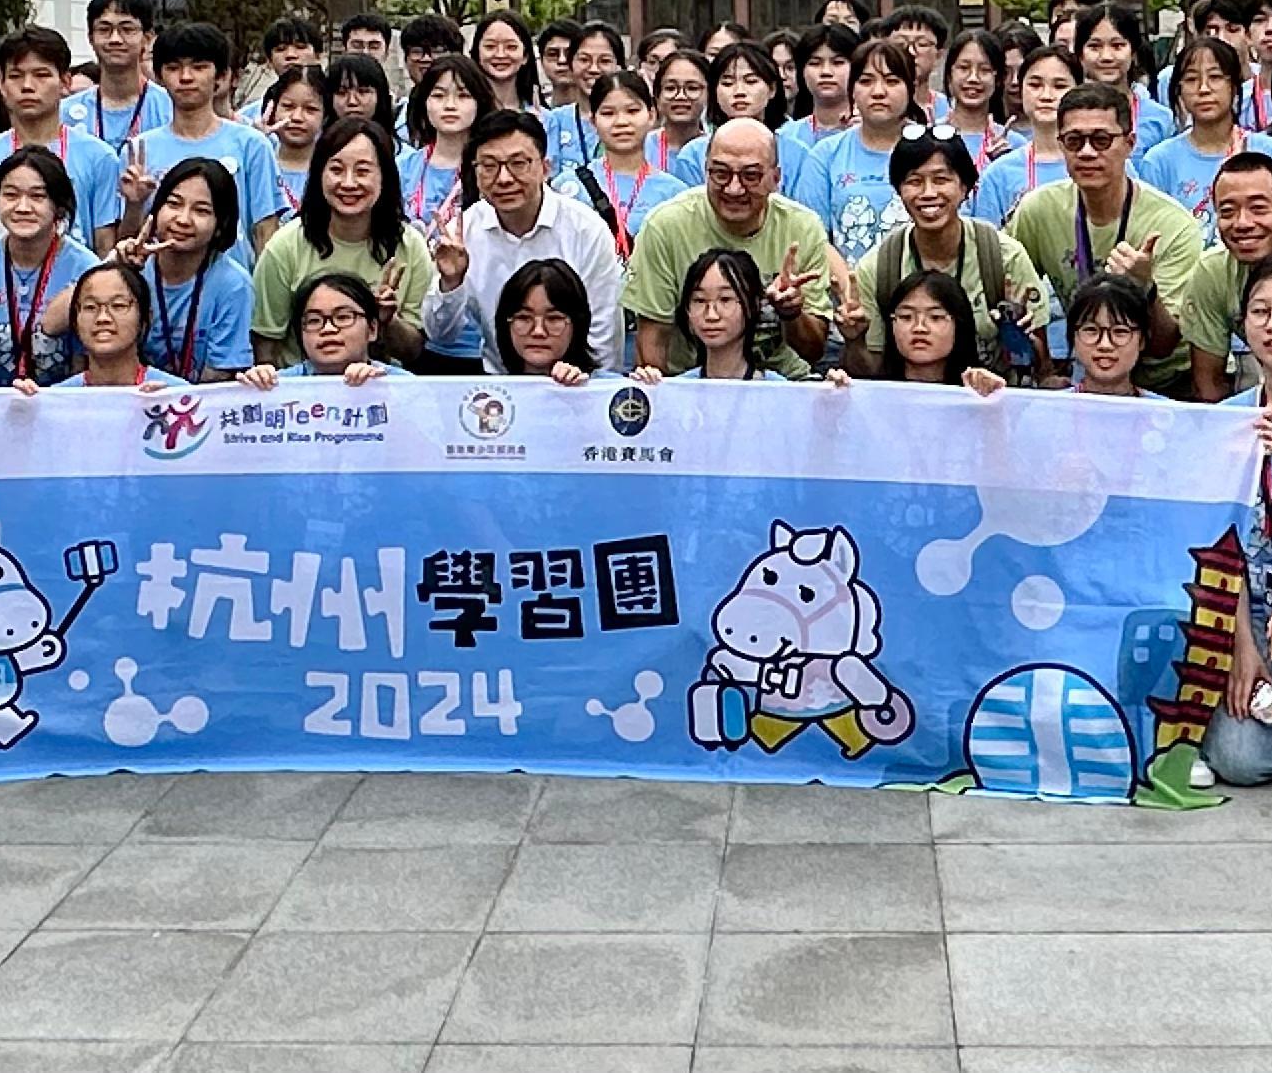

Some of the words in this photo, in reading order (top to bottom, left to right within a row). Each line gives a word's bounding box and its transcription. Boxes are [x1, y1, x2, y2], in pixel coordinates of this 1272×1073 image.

[260, 432, 284, 443] and
[314, 431, 384, 445] Programme
[136, 533, 680, 658] 杭州學習團
[303, 668, 523, 740] 2024
